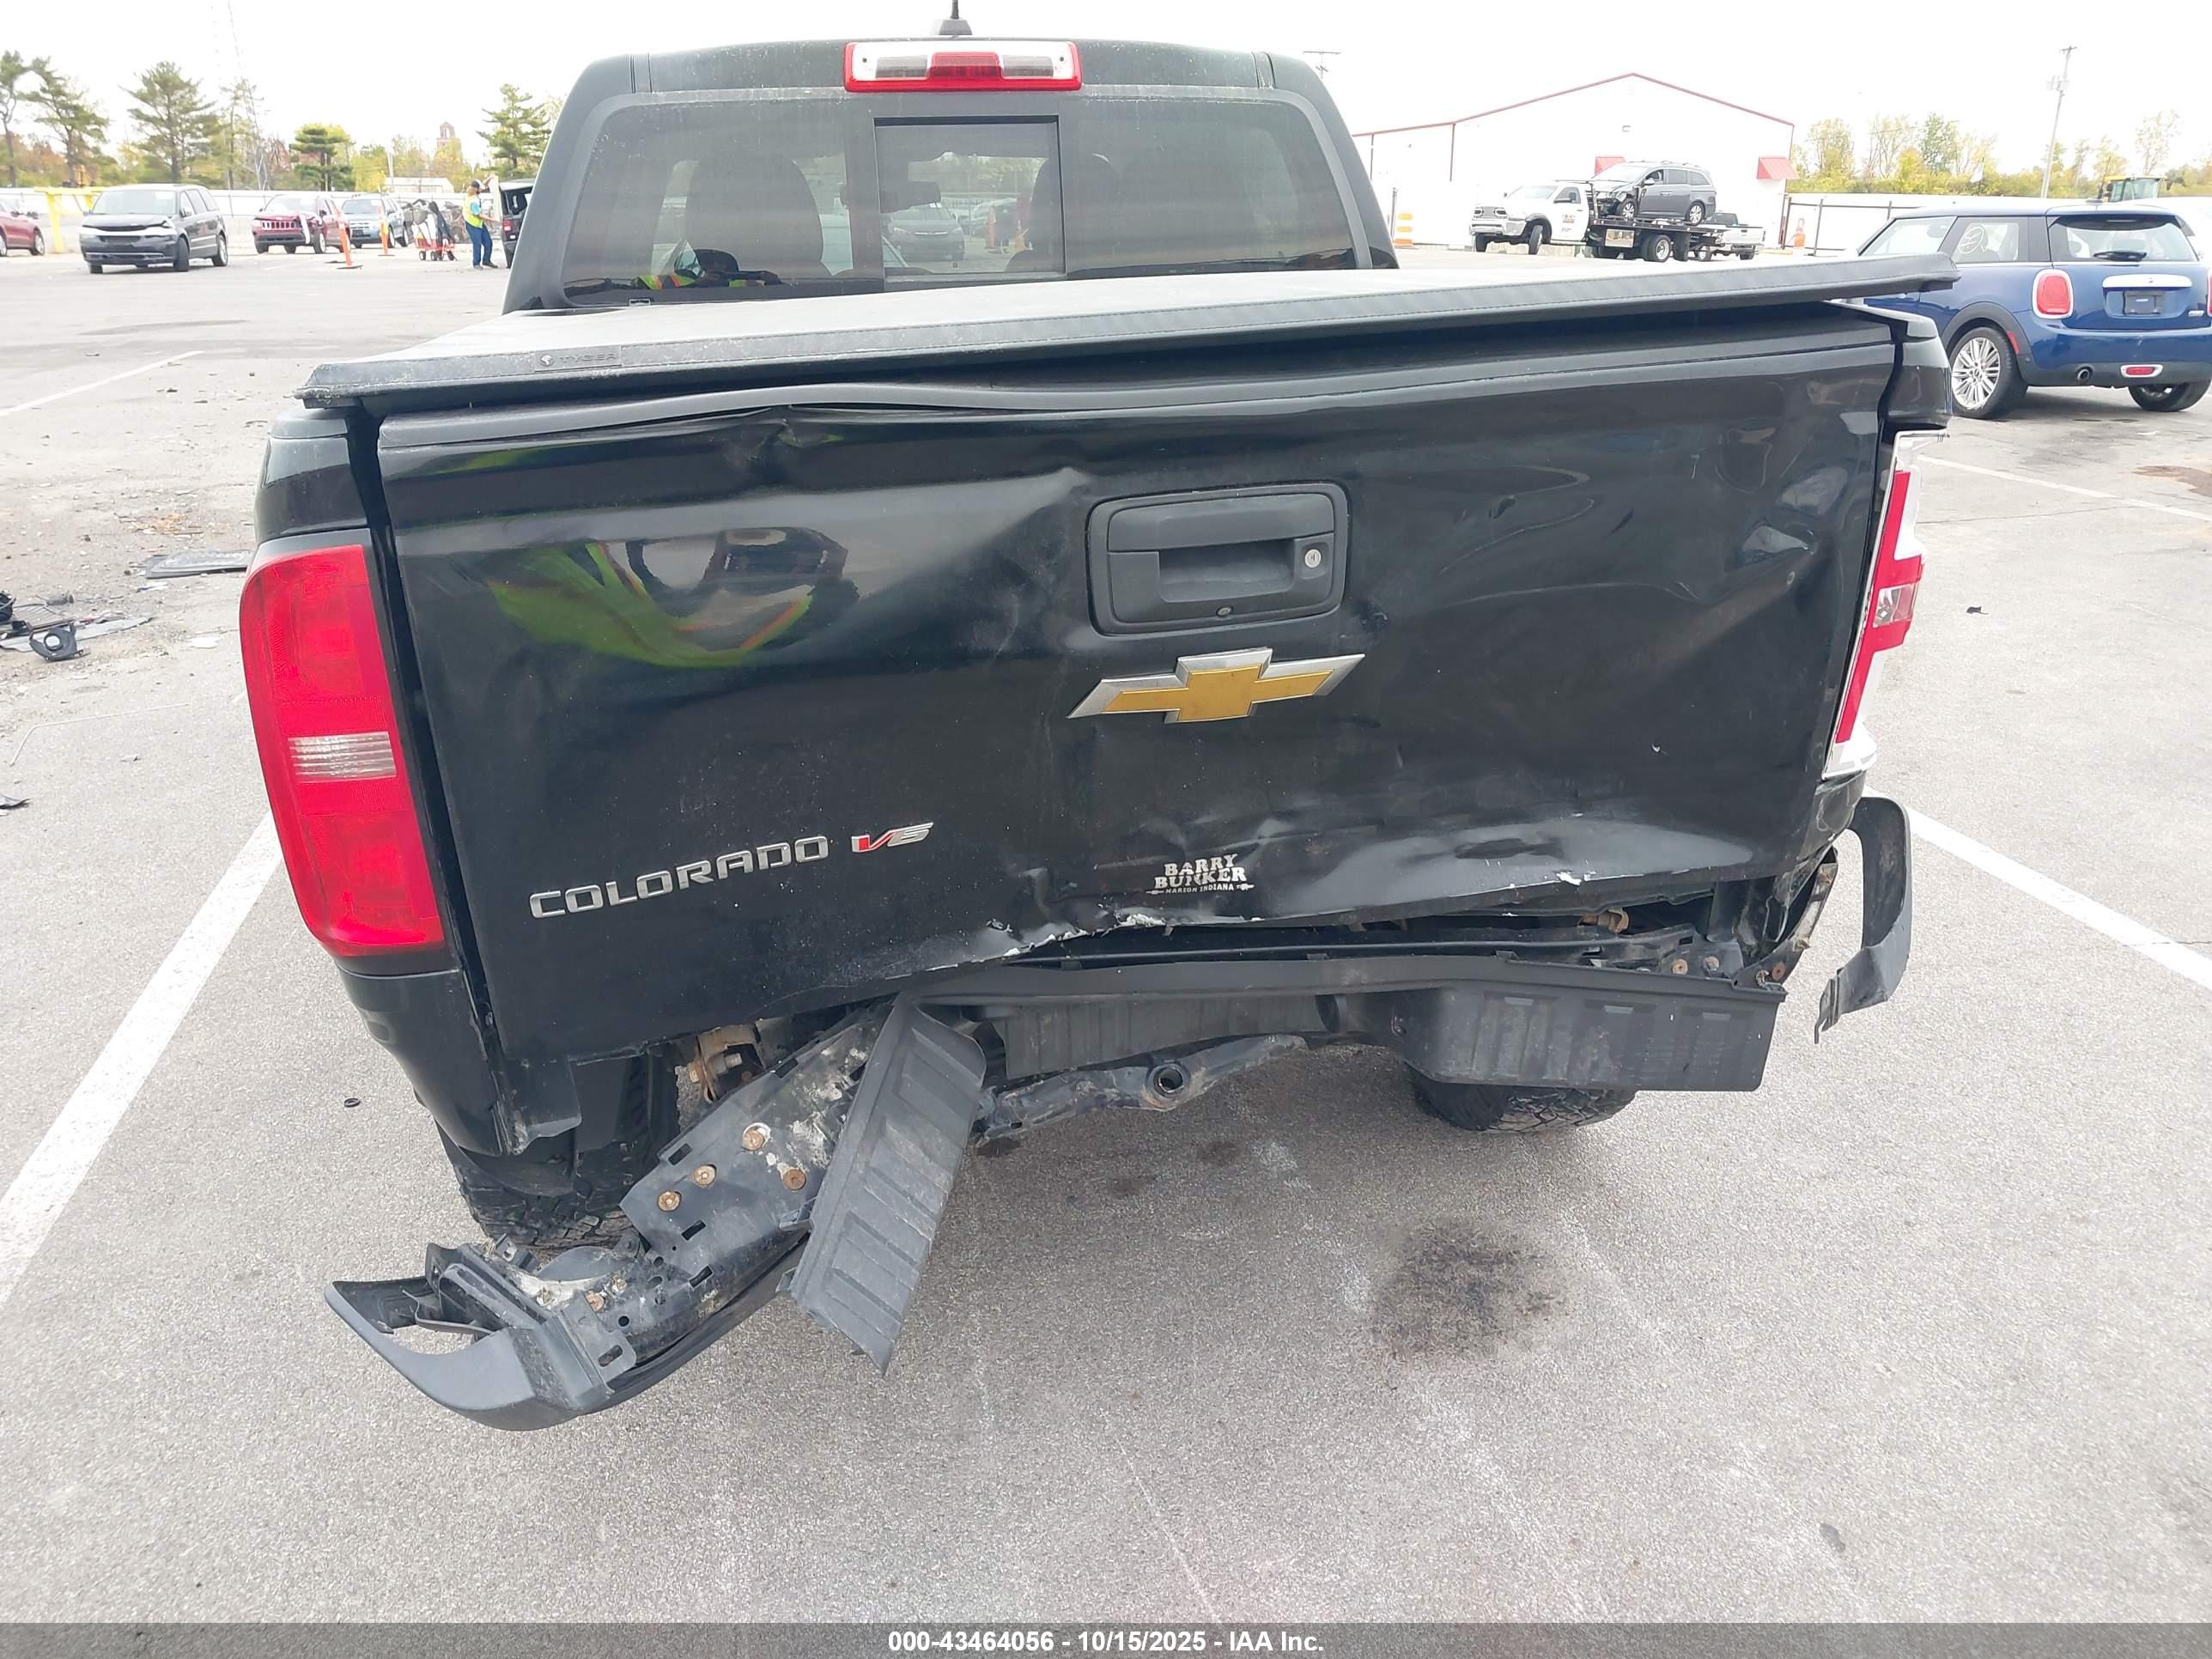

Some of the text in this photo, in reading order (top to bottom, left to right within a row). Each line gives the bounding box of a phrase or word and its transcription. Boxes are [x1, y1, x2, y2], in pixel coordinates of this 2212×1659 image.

[529, 822, 934, 919] COLORADO V6
[1164, 854, 1238, 877] BARRY
[1154, 867, 1247, 889] BUNKER
[1199, 883, 1234, 892] INDIANA
